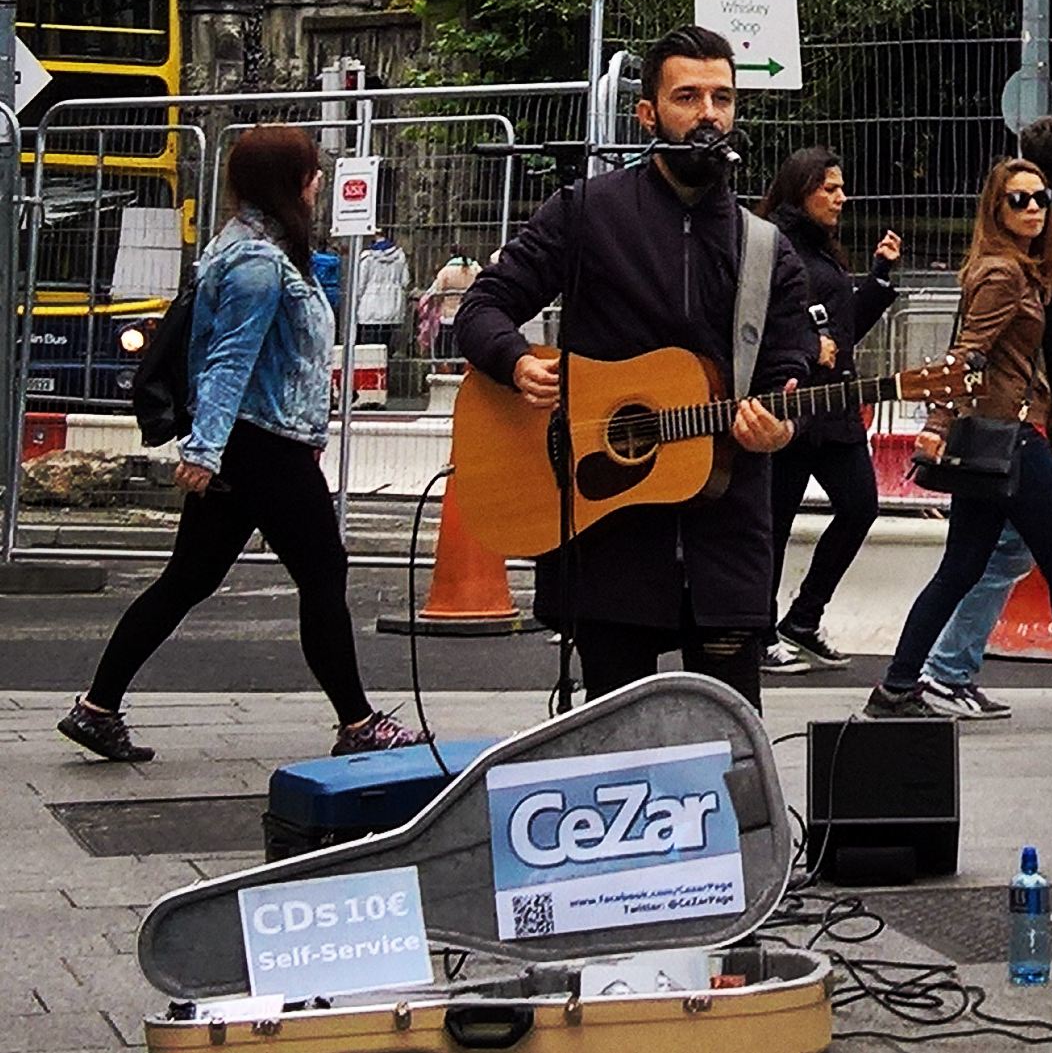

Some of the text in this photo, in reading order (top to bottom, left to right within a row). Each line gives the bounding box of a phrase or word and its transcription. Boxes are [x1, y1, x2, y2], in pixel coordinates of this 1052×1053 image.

[731, 18, 761, 36] Shop
[508, 780, 719, 869] CeZar
[253, 891, 409, 935] CDs 10€
[258, 934, 420, 971] Self-Service
